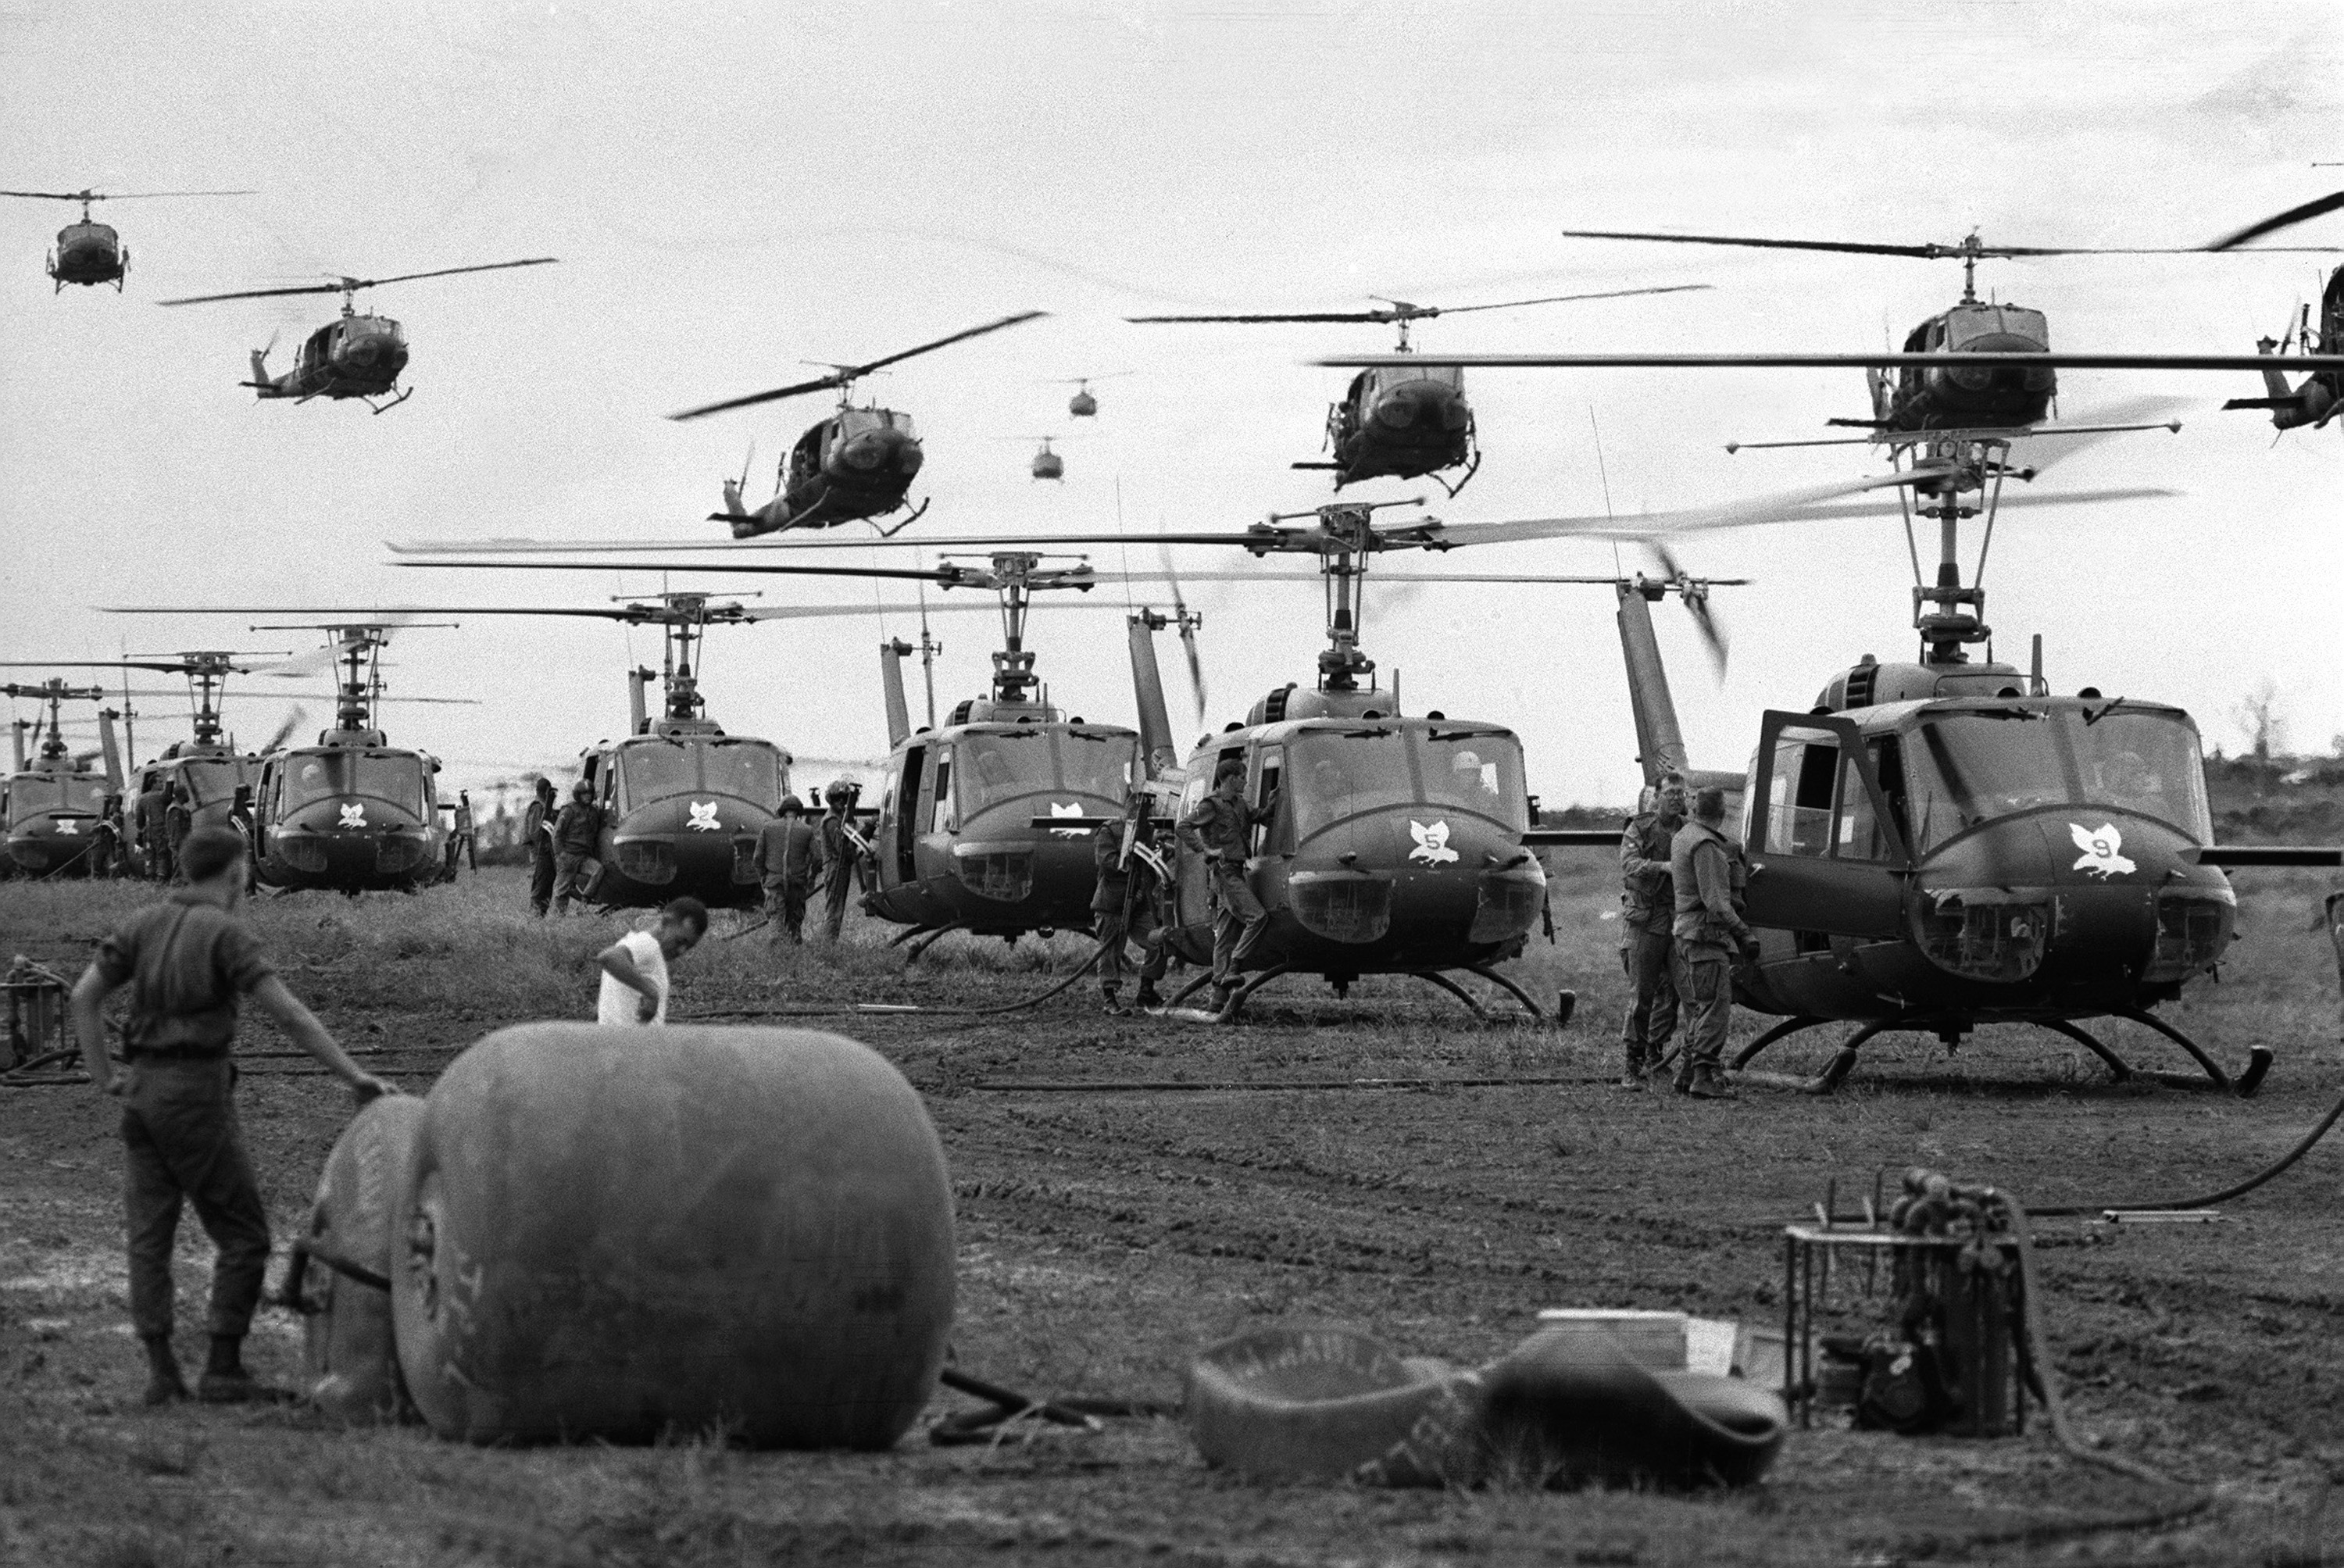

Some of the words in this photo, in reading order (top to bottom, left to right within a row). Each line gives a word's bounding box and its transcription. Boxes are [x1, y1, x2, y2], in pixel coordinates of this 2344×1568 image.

[699, 809, 709, 821] 2
[1424, 834, 1441, 850] 5
[2092, 839, 2113, 859] 9
